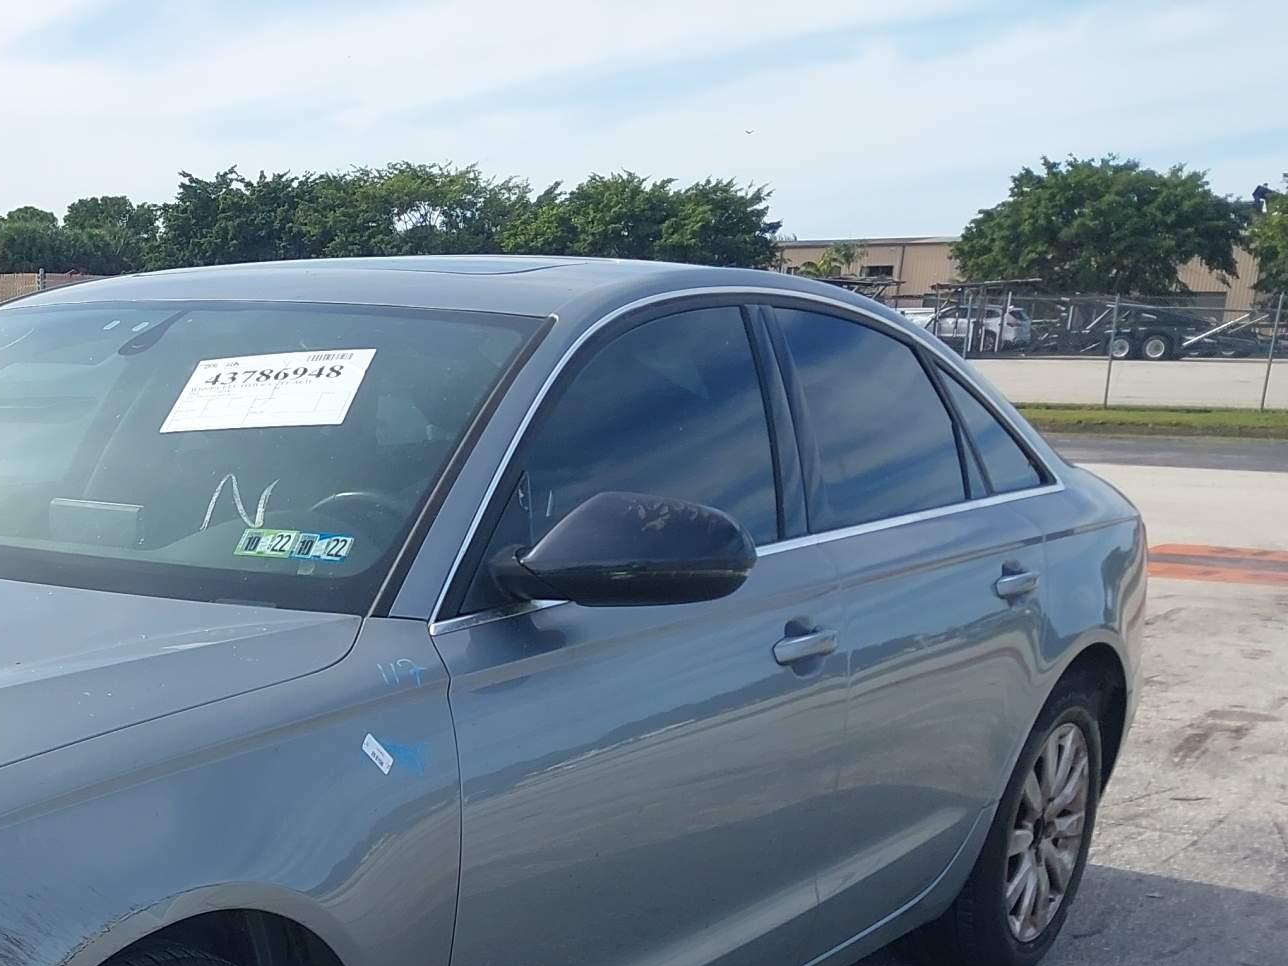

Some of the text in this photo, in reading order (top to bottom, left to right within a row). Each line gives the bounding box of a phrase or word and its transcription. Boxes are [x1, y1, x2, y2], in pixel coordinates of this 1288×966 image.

[205, 365, 344, 385] 43786948
[270, 534, 292, 553] 22
[326, 538, 348, 557] 22
